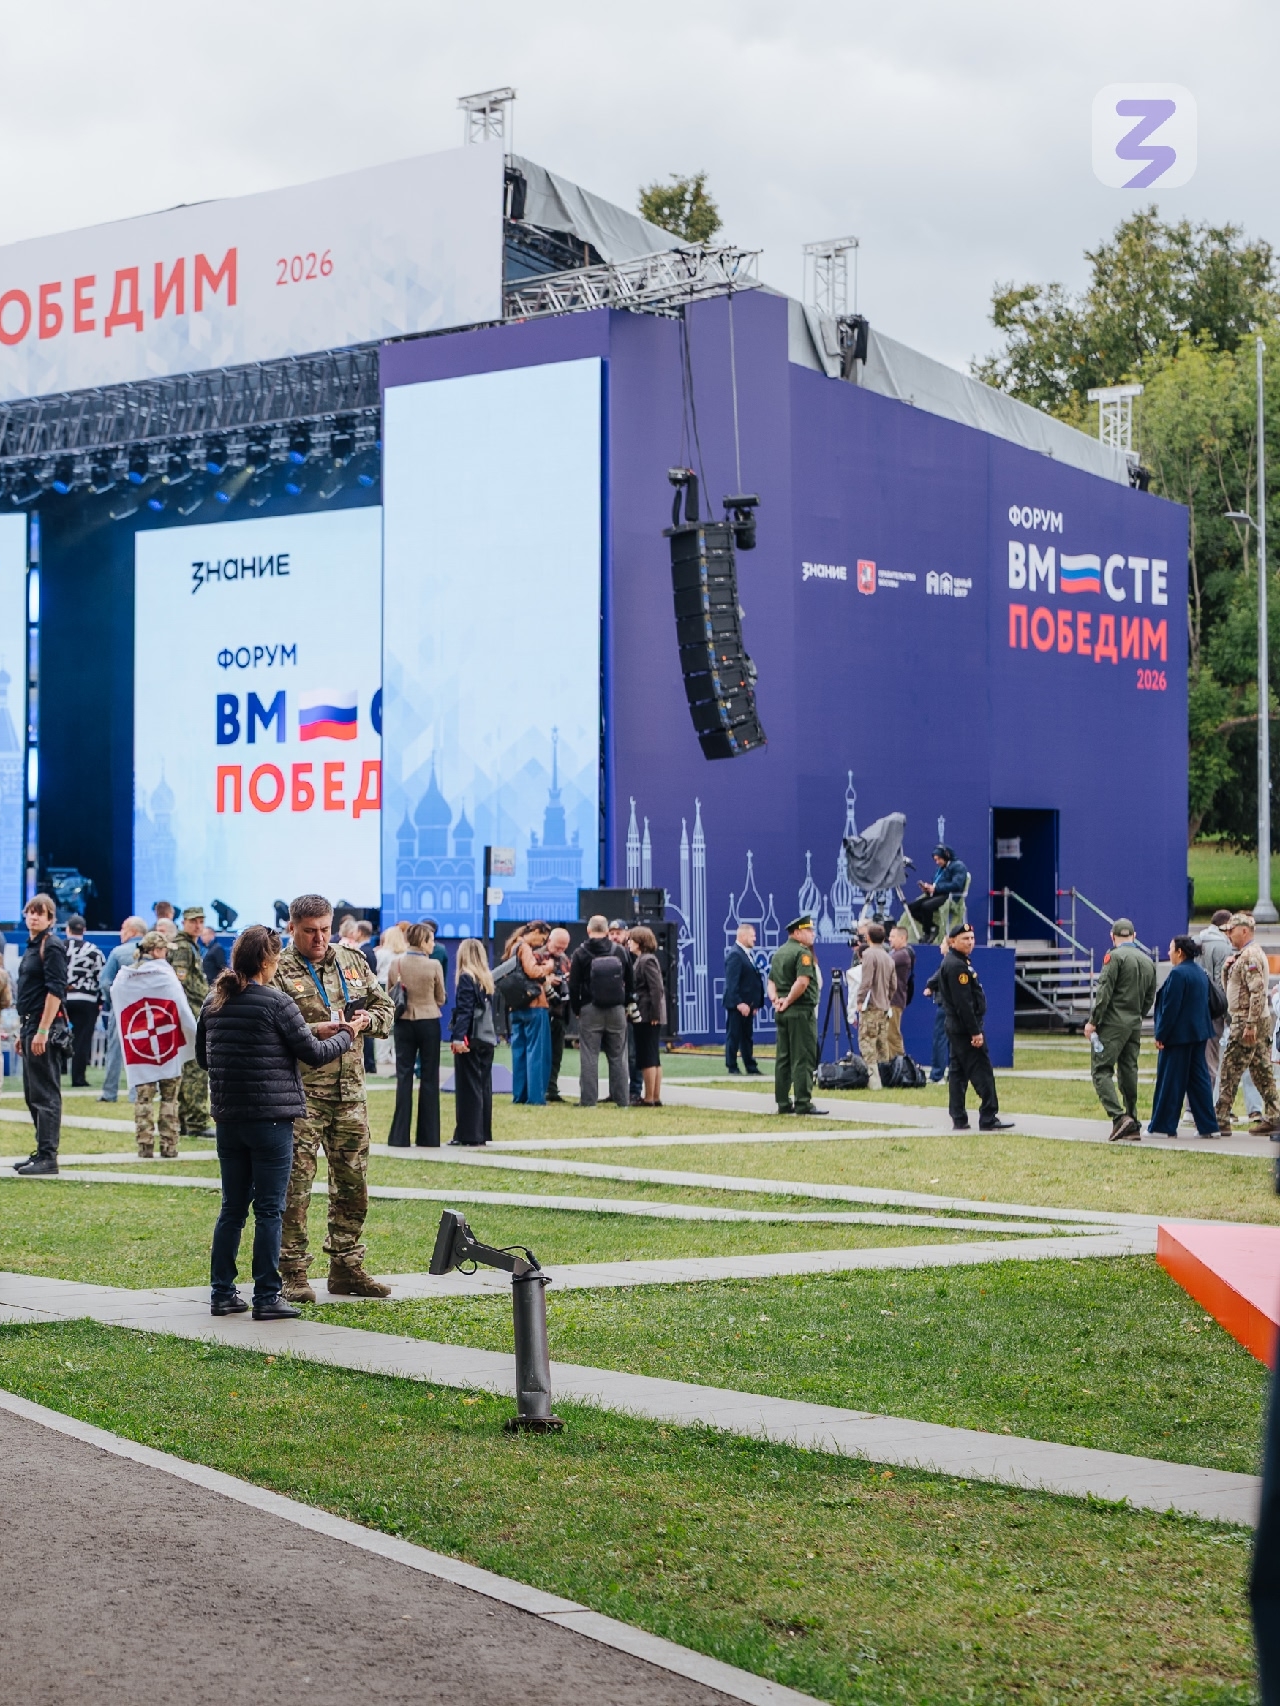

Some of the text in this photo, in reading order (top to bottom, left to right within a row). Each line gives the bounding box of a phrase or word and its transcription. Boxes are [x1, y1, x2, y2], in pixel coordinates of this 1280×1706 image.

[275, 249, 333, 286] 2026
[1008, 504, 1063, 534] ФОРУМ
[1008, 540, 1168, 606] ВМСТЕ
[1008, 603, 1168, 664] ПОБЕДИМ
[216, 643, 297, 671] ФОРУМ
[1136, 668, 1168, 691] 2026
